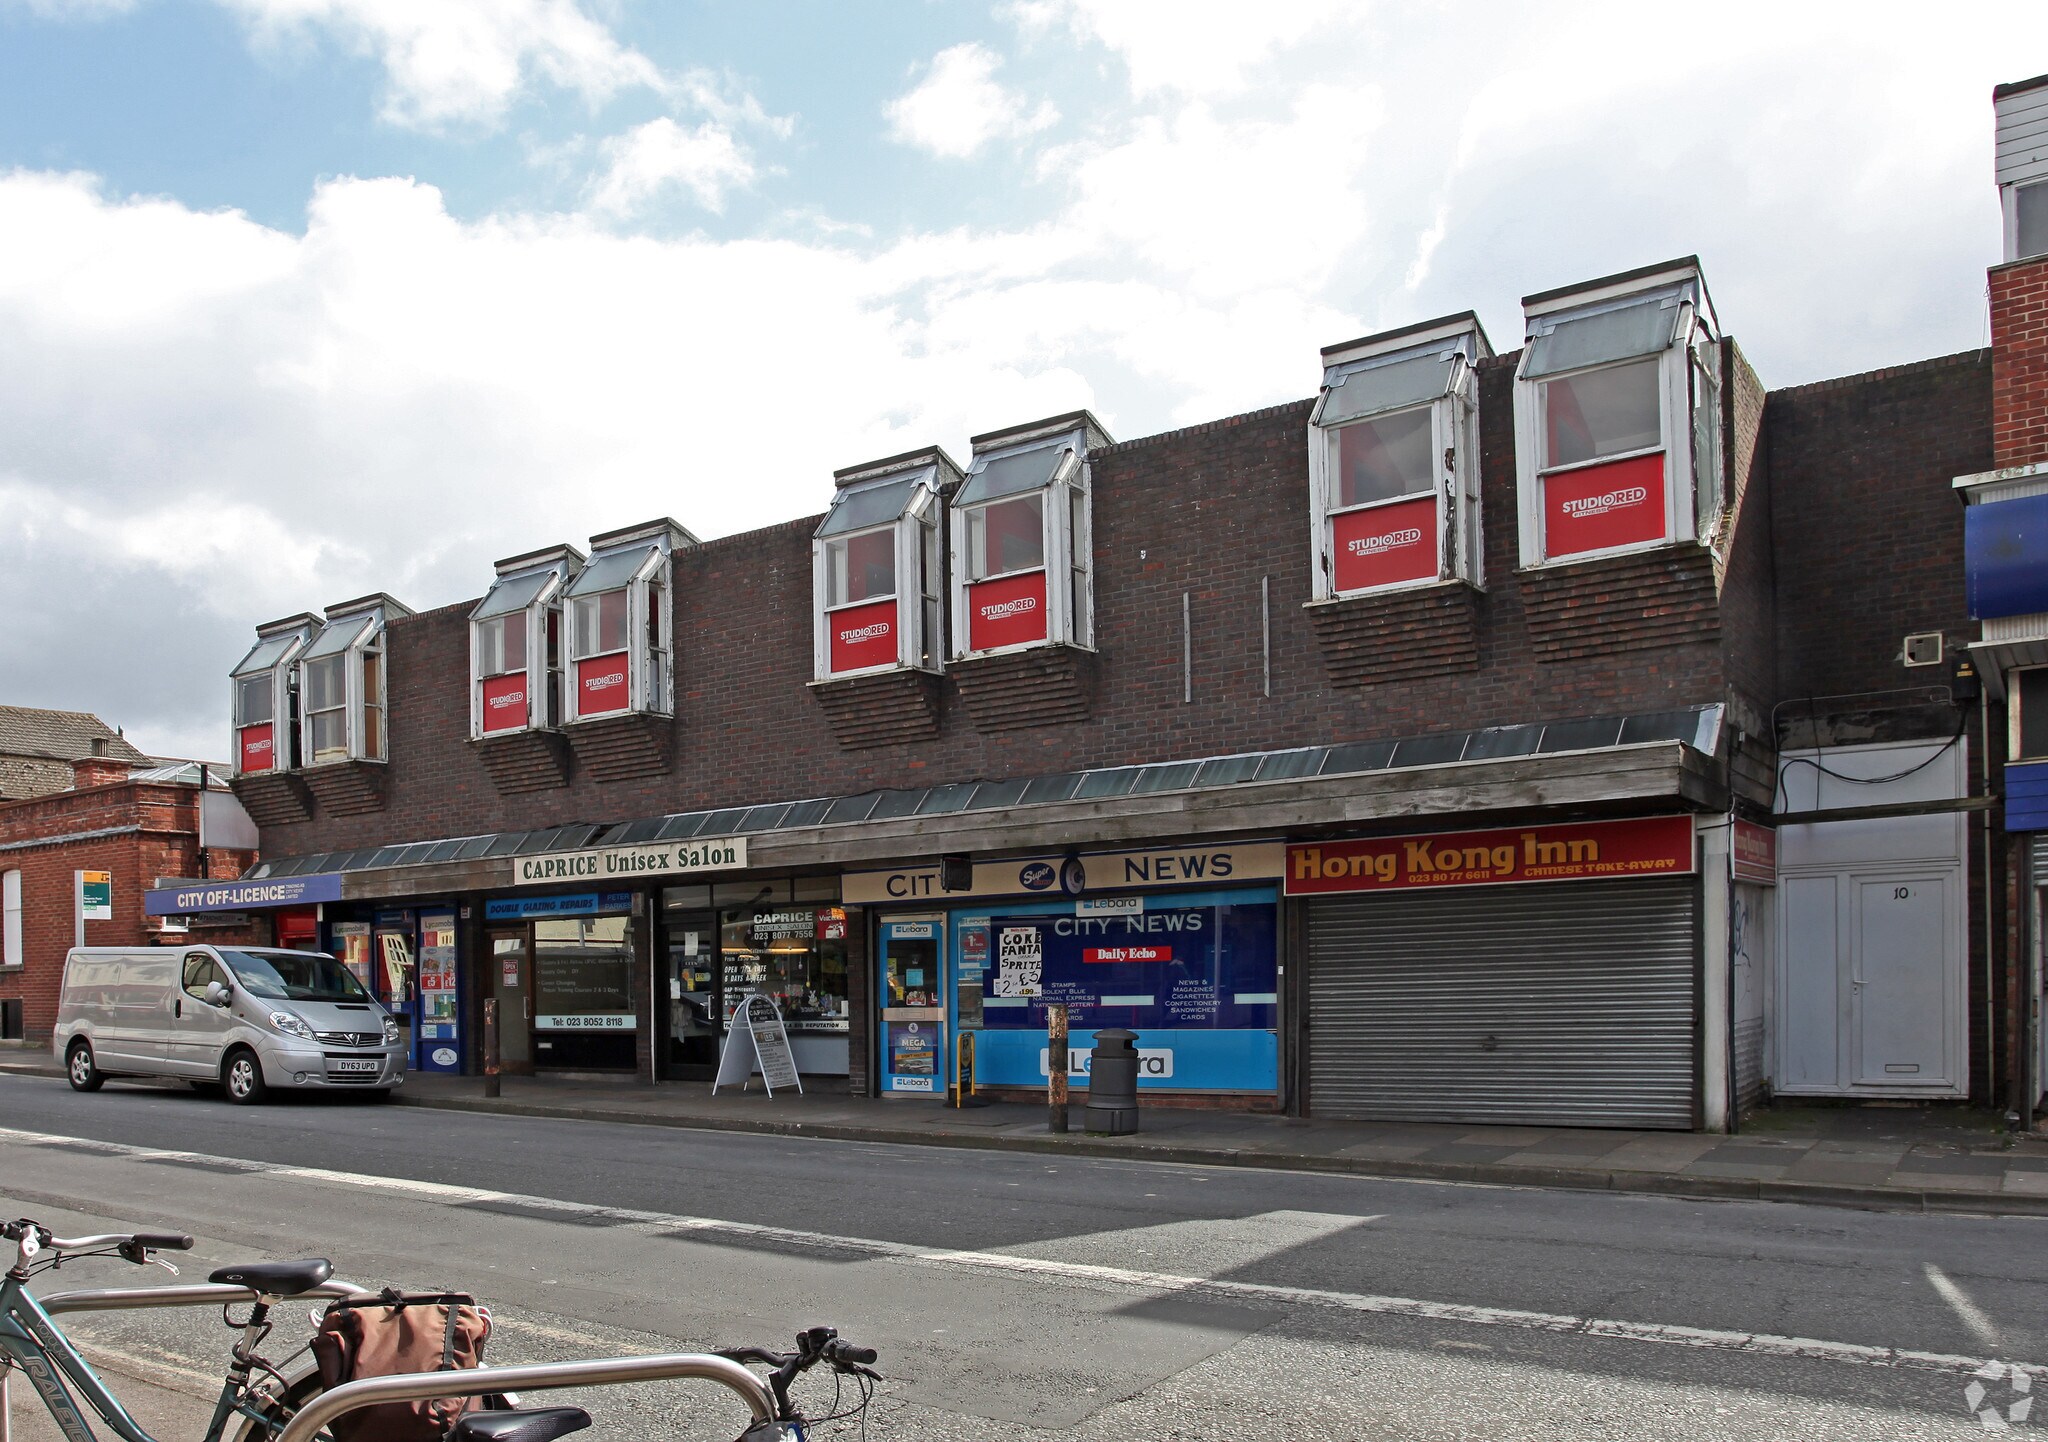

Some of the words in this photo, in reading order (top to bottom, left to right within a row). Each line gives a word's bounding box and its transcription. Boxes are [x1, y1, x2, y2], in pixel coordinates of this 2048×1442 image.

[523, 856, 597, 880] CAPRICE
[606, 850, 670, 873] Unisex
[678, 845, 736, 868] Salon
[1292, 849, 1396, 882] Hong
[1403, 840, 1514, 874] Kong
[1520, 834, 1598, 865] Inn
[1124, 854, 1233, 882] NEWS
[1524, 865, 1583, 876] CHINESE
[1586, 859, 1675, 872] TAKE-AWAY
[1409, 874, 1430, 883] 023
[1433, 873, 1447, 881] 80
[1466, 871, 1490, 880] 6611
[178, 892, 204, 908] CITY
[206, 885, 285, 905] OFF-LICENCE
[1894, 887, 1909, 900] 10
[490, 904, 519, 913] DOUBLE
[522, 901, 556, 912] GLAZING
[560, 899, 593, 909] REPAIRS
[1094, 898, 1136, 908] Lebara
[754, 912, 813, 924] CAPRICE
[1054, 918, 1111, 936] CITY
[1126, 913, 1202, 933] NEWS
[754, 932, 768, 940] 023
[773, 931, 790, 939] 8077
[1004, 933, 1041, 945] COKE
[1001, 945, 1040, 956] FANTA
[1098, 950, 1127, 961] Daily
[1129, 948, 1156, 959] Echo
[1001, 958, 1041, 970] SPRITE
[1071, 1052, 1164, 1074] Lera
